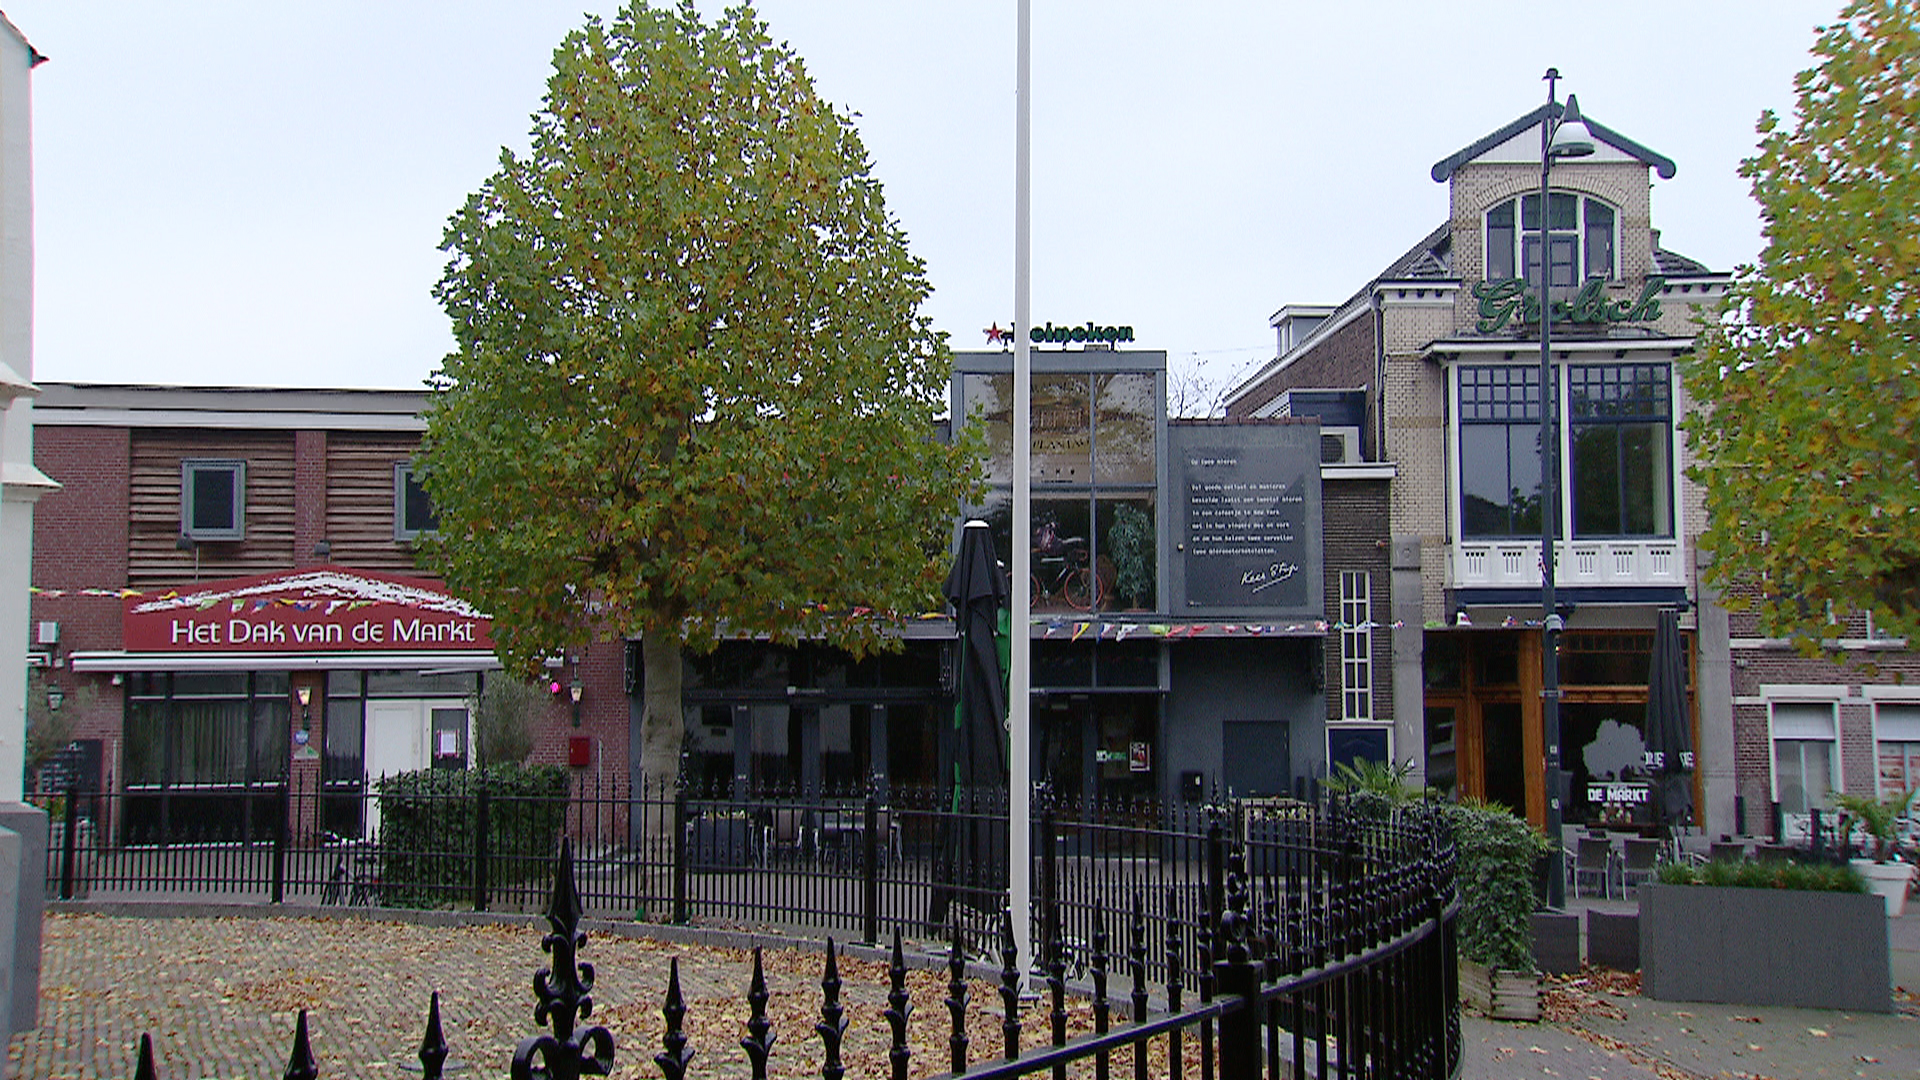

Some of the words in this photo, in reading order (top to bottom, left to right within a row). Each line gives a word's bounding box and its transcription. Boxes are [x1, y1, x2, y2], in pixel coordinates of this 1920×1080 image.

[1473, 276, 1666, 333] Grolsch
[1010, 322, 1136, 343] eineken
[172, 619, 221, 644] Het
[229, 619, 285, 644] Dak
[293, 624, 343, 643] van
[352, 619, 384, 643] de
[393, 618, 475, 643] Markt
[1587, 788, 1603, 802] DE
[1607, 788, 1649, 802] MARKT
